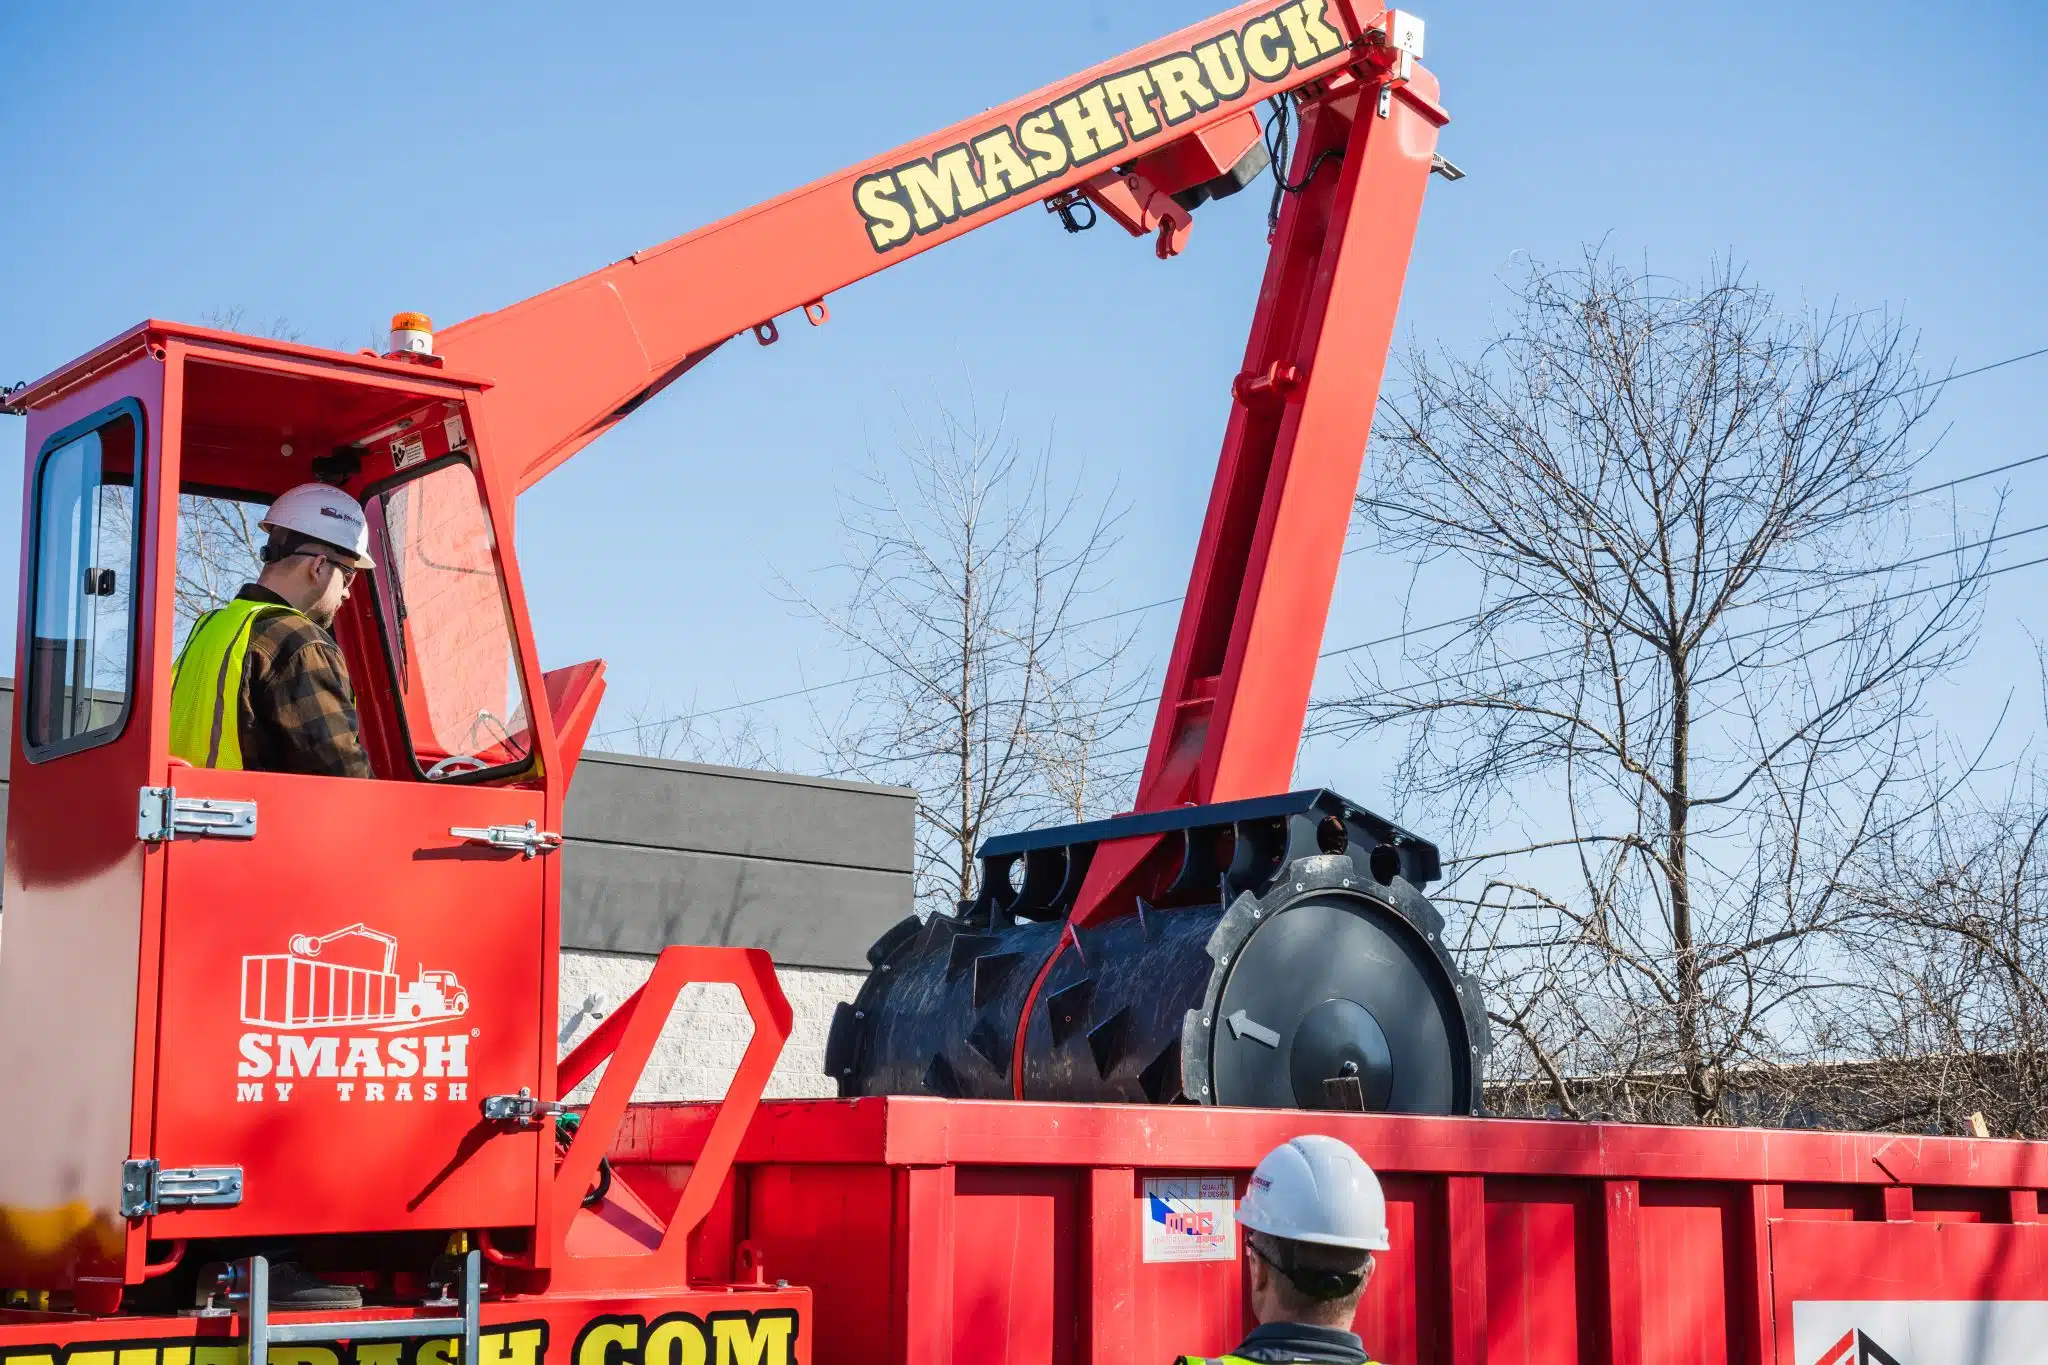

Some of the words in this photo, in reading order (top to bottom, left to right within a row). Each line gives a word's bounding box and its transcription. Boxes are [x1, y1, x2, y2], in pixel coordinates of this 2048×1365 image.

[855, 0, 1343, 249] SMASHTRUCK
[238, 1032, 469, 1078] SMASH
[237, 1082, 293, 1102] MY
[337, 1082, 467, 1102] TRASH
